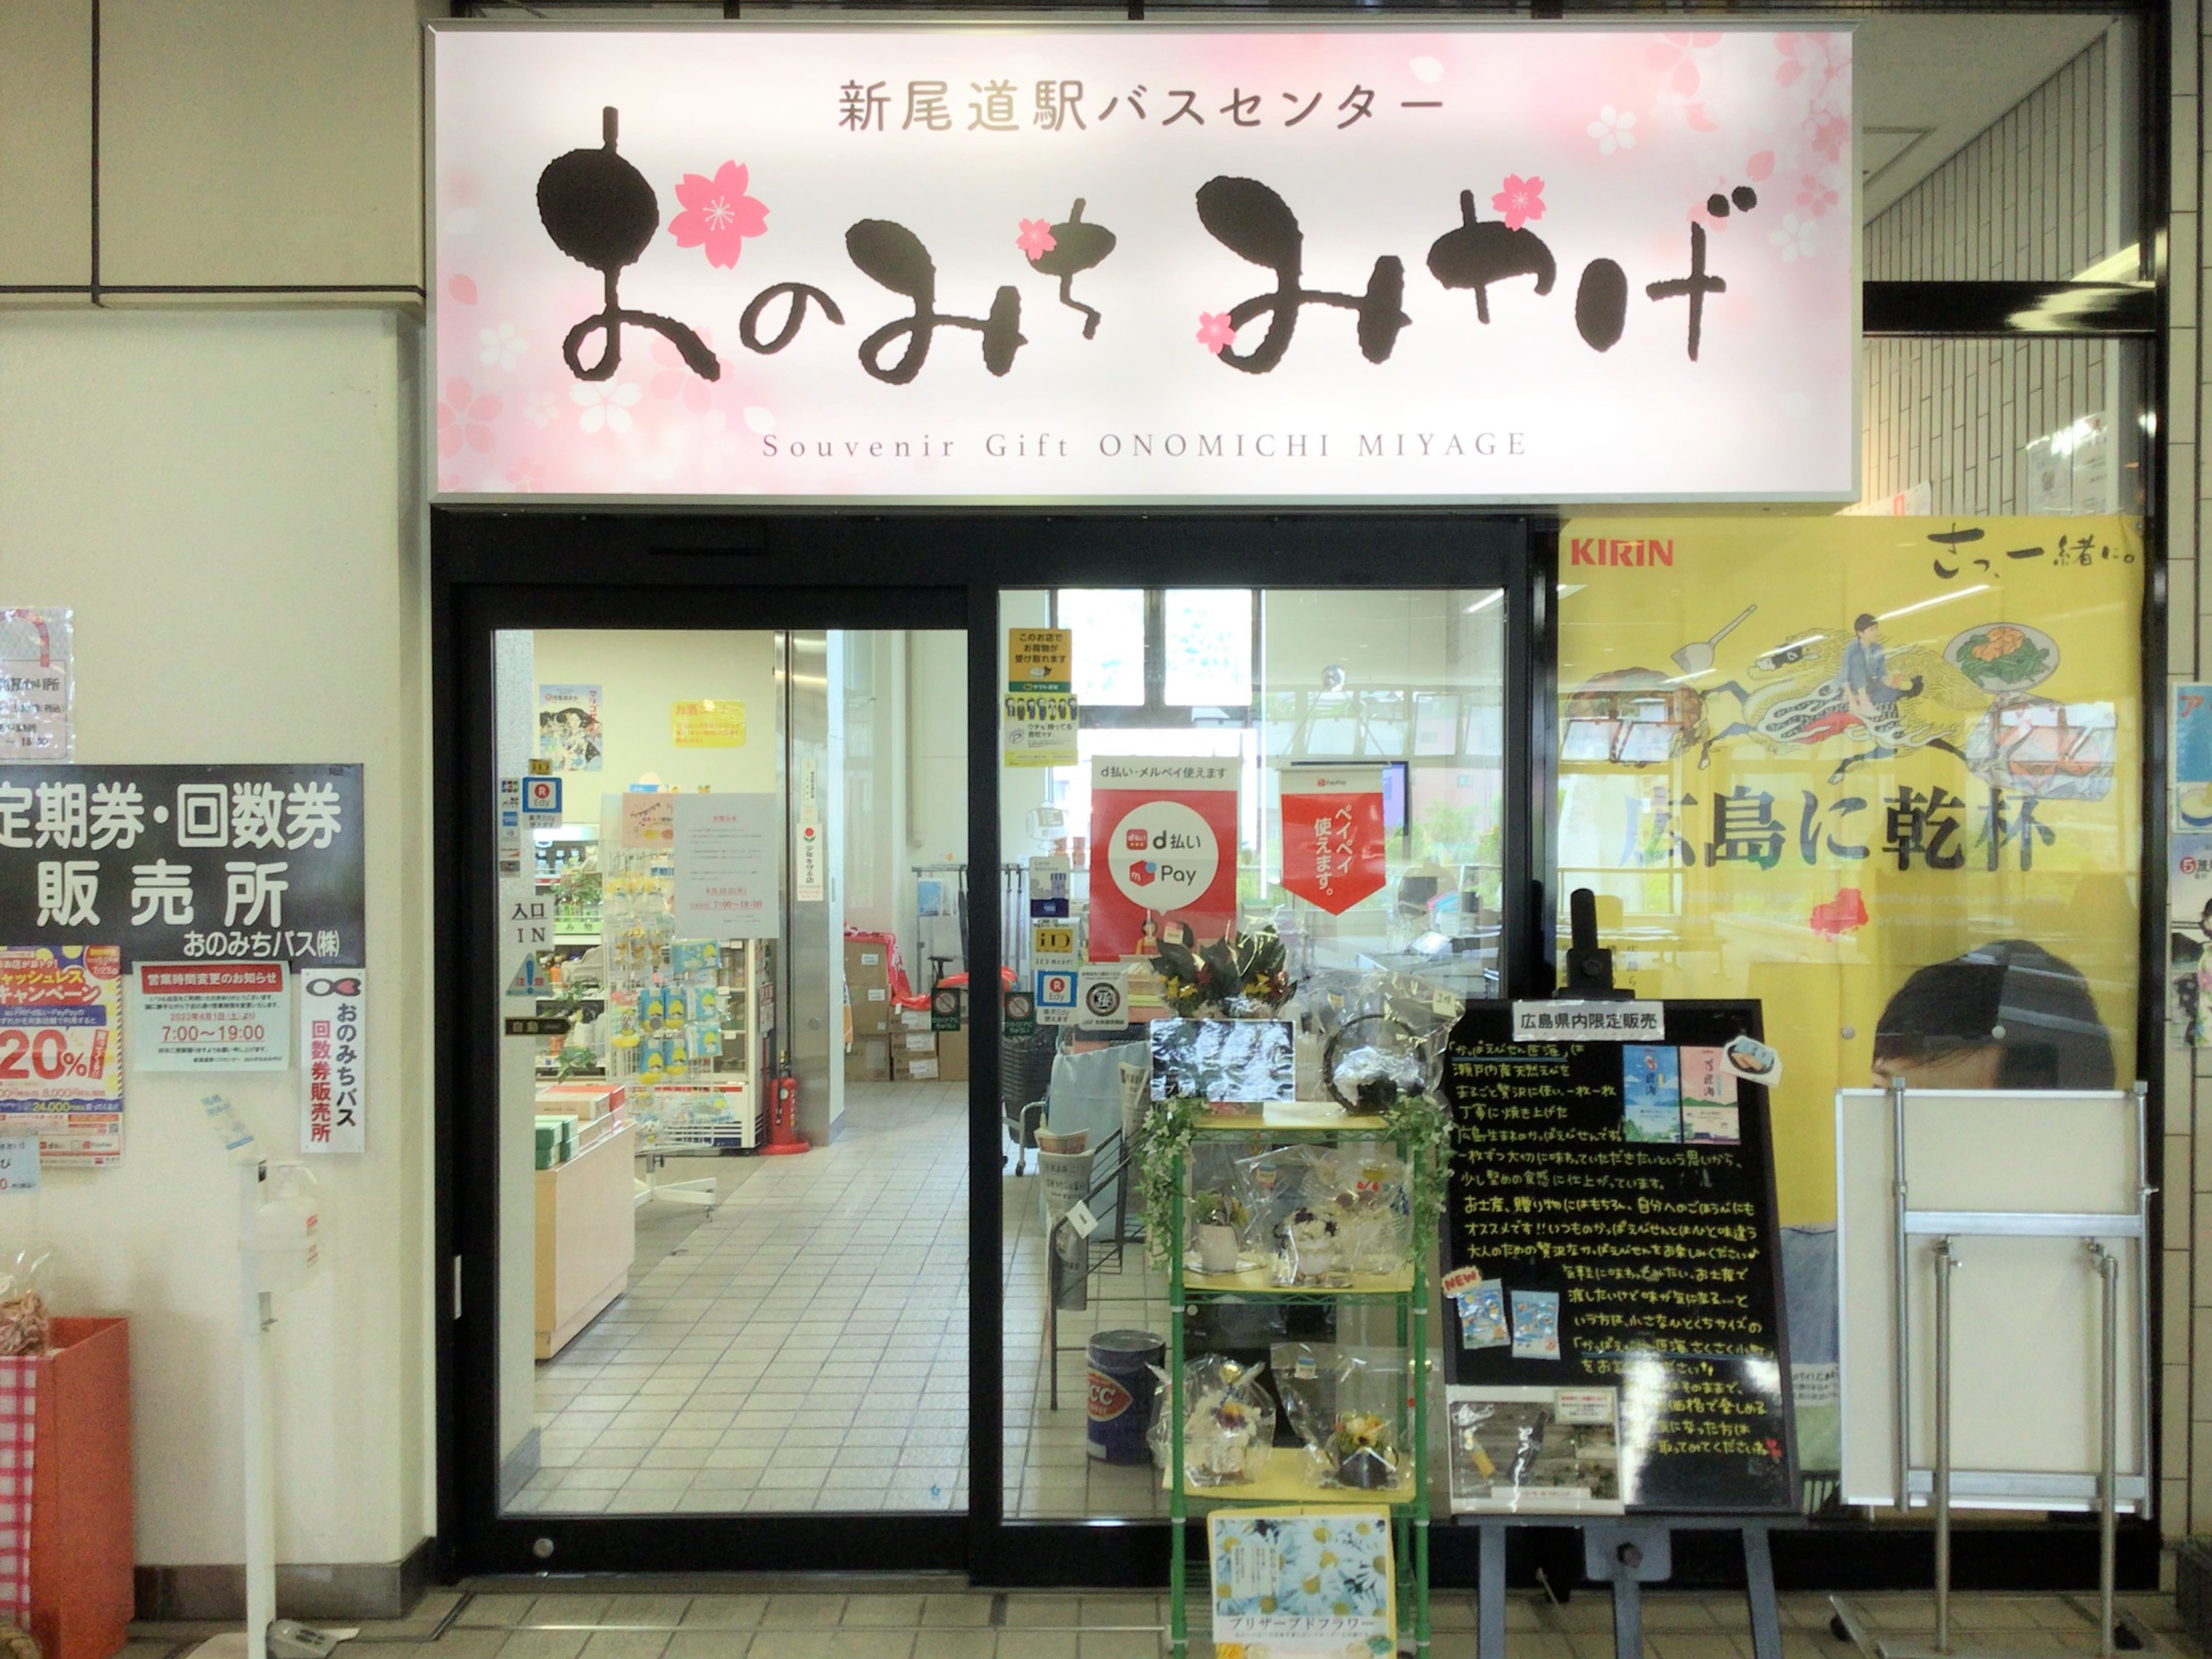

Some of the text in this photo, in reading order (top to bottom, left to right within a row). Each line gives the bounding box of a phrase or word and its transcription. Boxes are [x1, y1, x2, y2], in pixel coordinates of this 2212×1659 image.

[839, 79, 1444, 132] 新尾道駅バスセンター
[535, 104, 1759, 386] おのみち みやげ
[762, 431, 1528, 459] Souvenir Gift ONOMICHI MIYAGE
[1570, 539, 1674, 567] KIRIN
[1019, 634, 1063, 642] このお店で
[1024, 644, 1059, 653] お荷物が
[1015, 655, 1067, 663] 受け取れます
[1101, 766, 1228, 779] d払い・メルペイ使えます
[534, 798, 550, 808] Edy
[0, 781, 342, 851] 定期券・回数券
[1334, 804, 1354, 874] ペイペイ
[1621, 783, 2056, 874] 広島に乾杯
[1153, 830, 1202, 850] d払い
[1313, 817, 1334, 896] 使えます。
[1161, 865, 1197, 886] Pay
[37, 858, 289, 928] 販売所
[512, 902, 546, 920] 入口
[1040, 933, 1071, 948] iD
[147, 972, 277, 985] 営業時間変更のお知らせ
[1048, 993, 1065, 1002] Edy
[1520, 1012, 1659, 1031] 広島県内限定販売
[336, 1003, 358, 1128] おのみちバス
[311, 1020, 332, 1143] 回数券販売所
[1444, 1270, 1477, 1291] NEW
